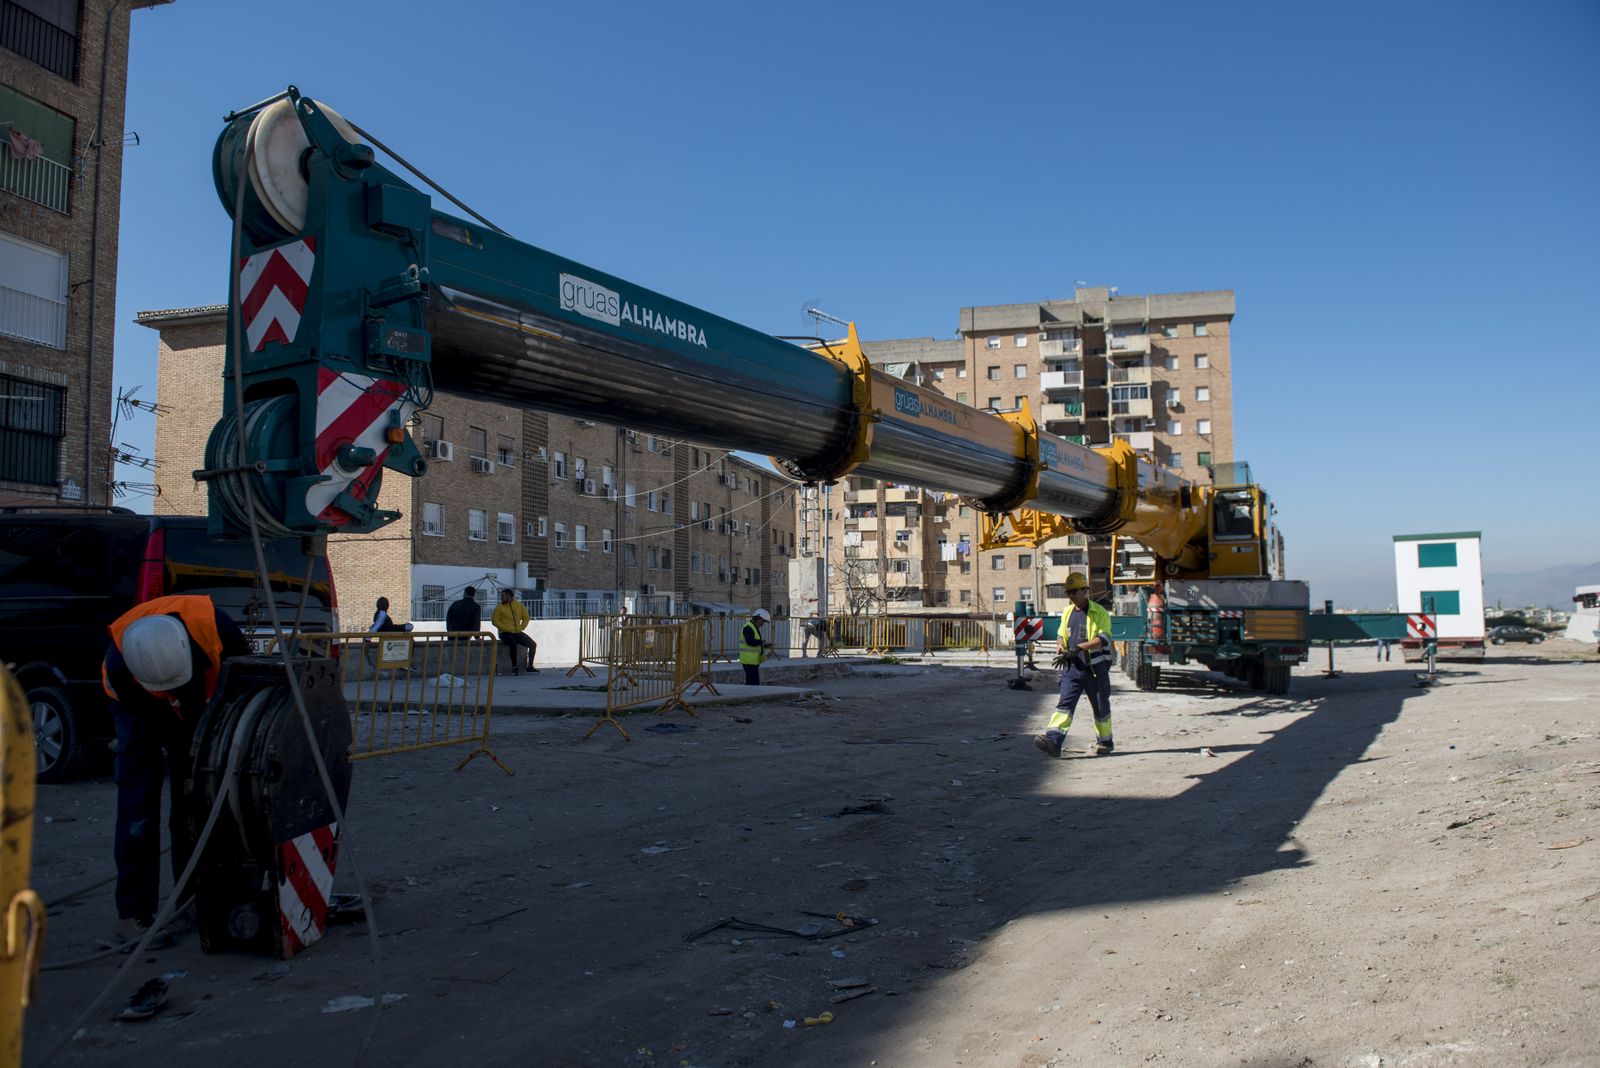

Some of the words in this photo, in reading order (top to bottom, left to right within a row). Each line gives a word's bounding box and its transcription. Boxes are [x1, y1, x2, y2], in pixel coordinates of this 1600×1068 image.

[562, 281, 618, 317] grúas
[621, 301, 708, 348] ALHAMBRA
[920, 401, 957, 425] ALHAMBRA
